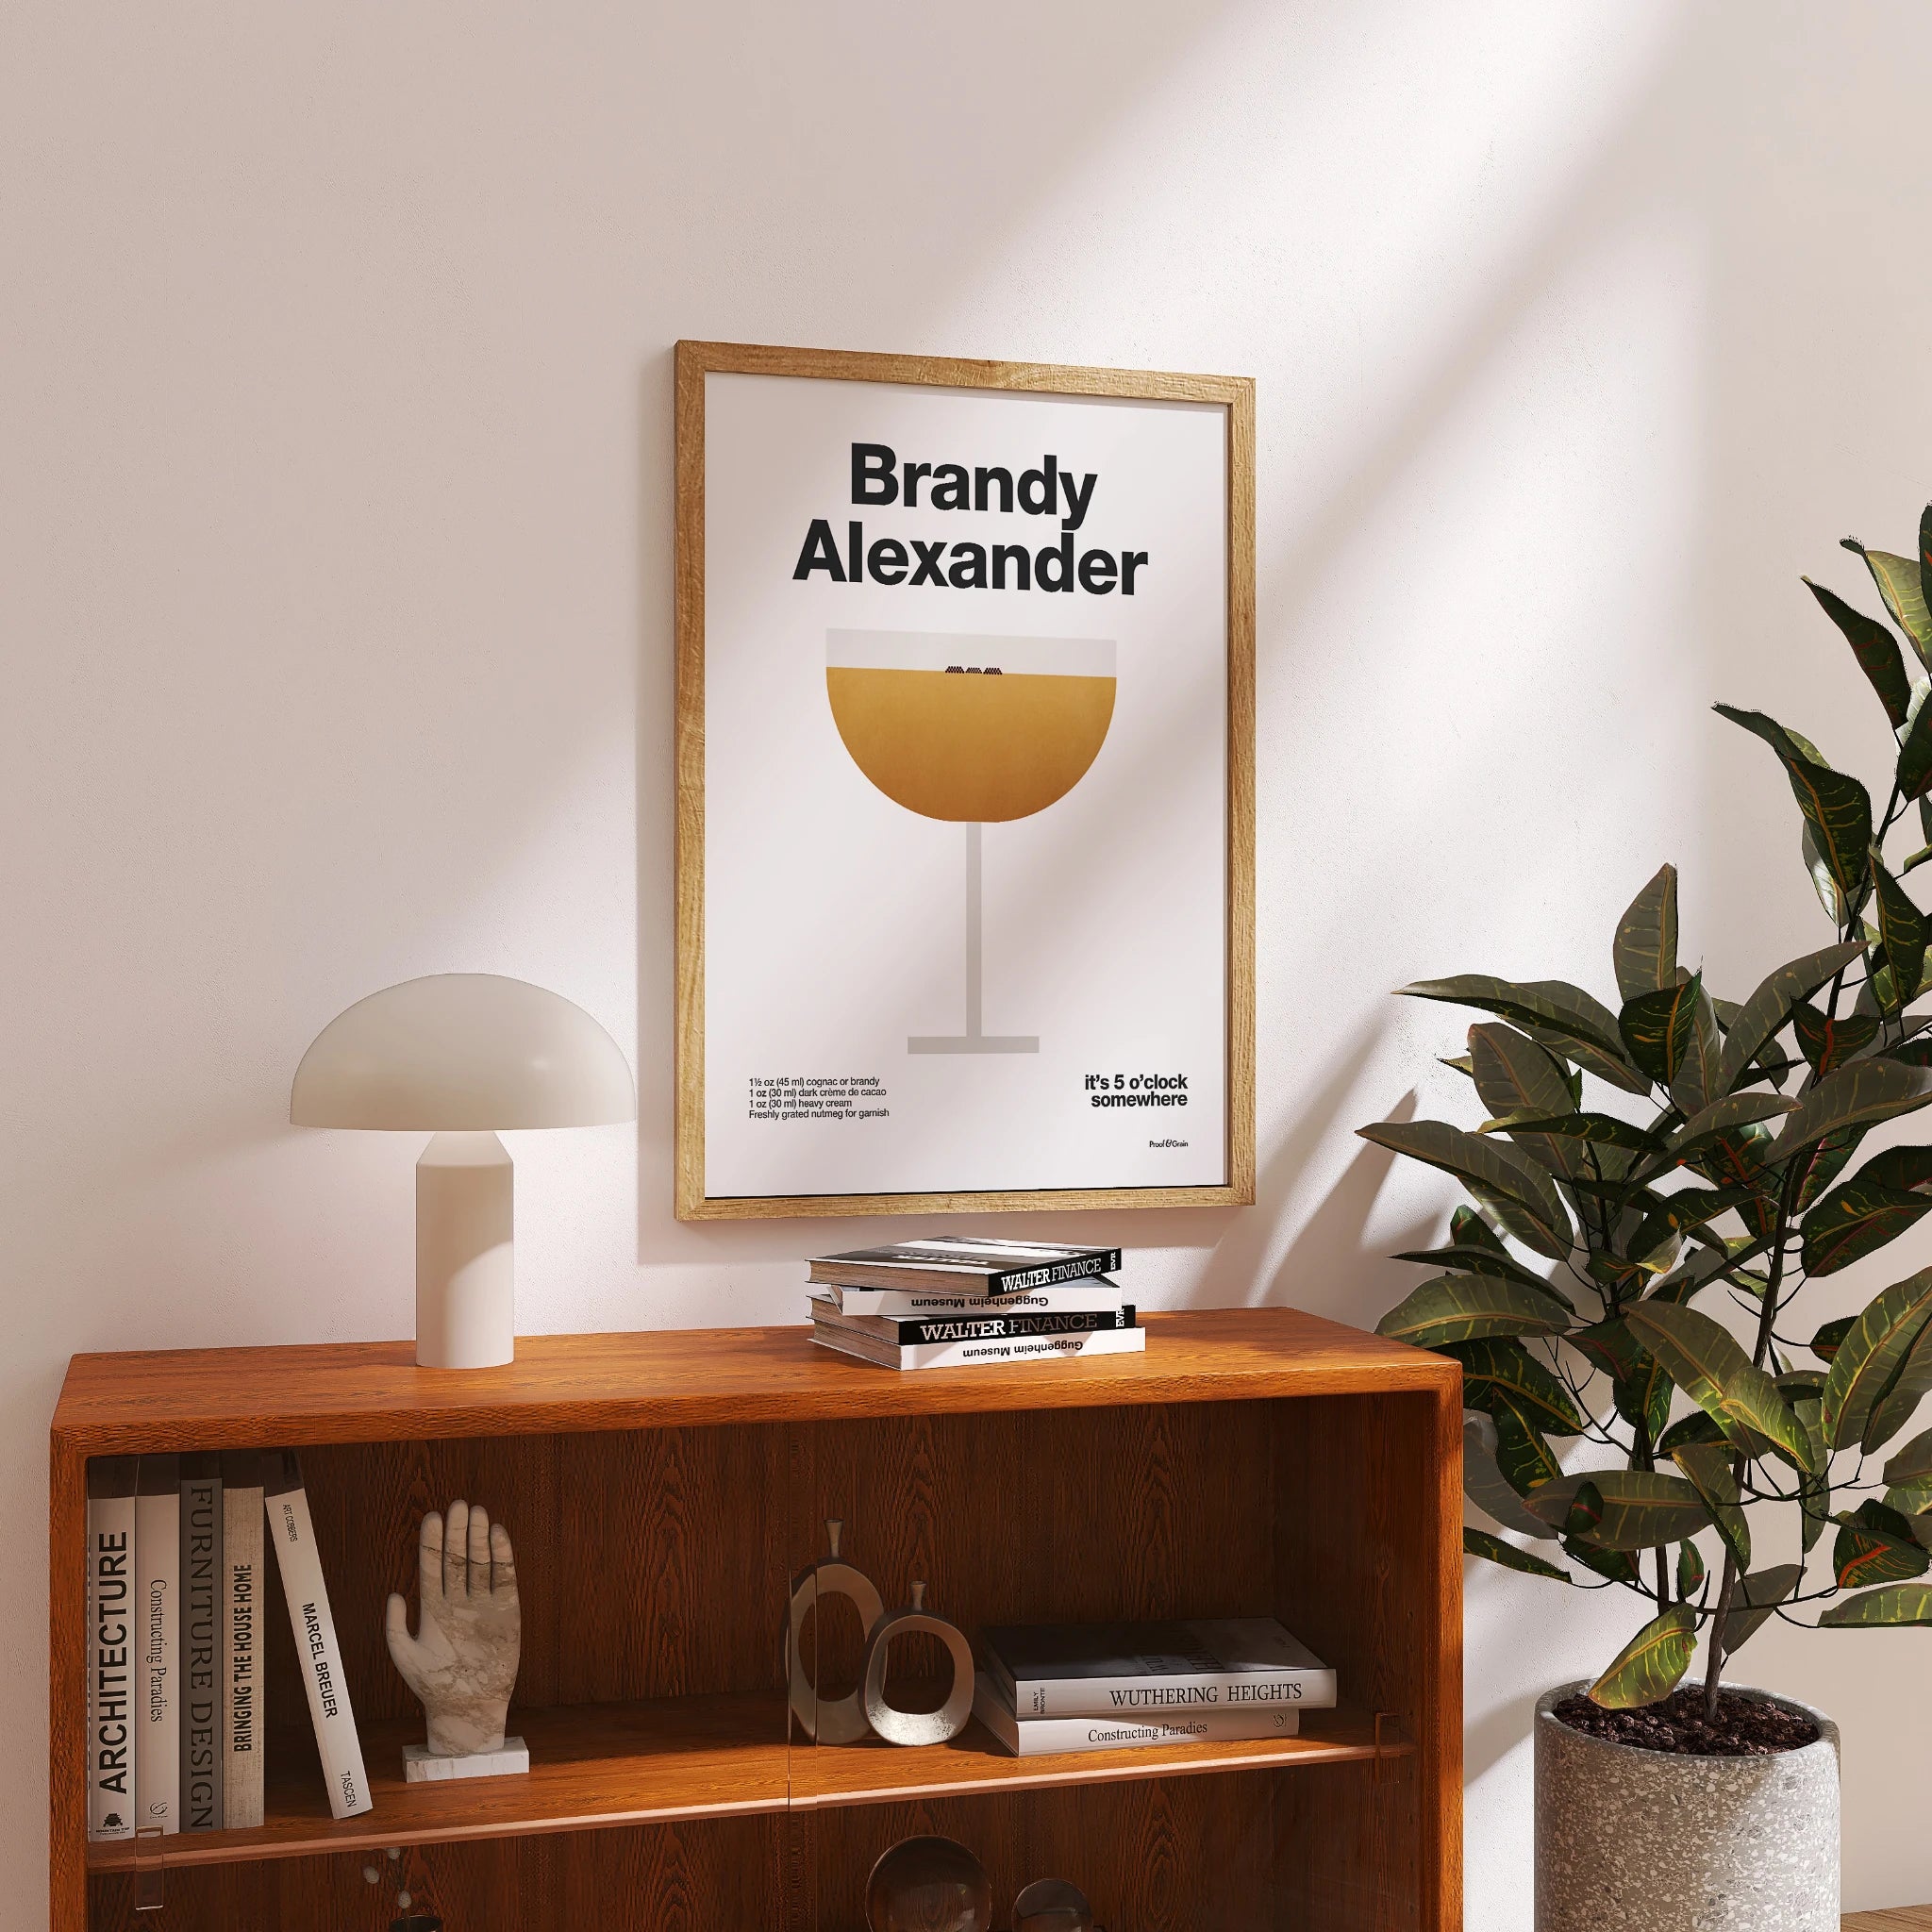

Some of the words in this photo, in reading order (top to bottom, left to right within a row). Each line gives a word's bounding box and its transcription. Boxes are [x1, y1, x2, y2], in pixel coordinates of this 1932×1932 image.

[851, 442, 1098, 530] Brandy
[792, 519, 1148, 595] Alexander
[749, 1089, 754, 1097] 1
[769, 1089, 782, 1098] (30
[784, 1088, 796, 1098] ml)
[798, 1088, 818, 1097] dark
[820, 1088, 846, 1096] crème
[848, 1088, 859, 1096] de
[776, 1077, 790, 1088] (45
[791, 1077, 804, 1088] ml)
[806, 1078, 838, 1088] cognac
[840, 1077, 849, 1086] or
[851, 1076, 880, 1088] brandy
[1113, 1074, 1125, 1090] 5
[769, 1099, 782, 1109] (30
[784, 1099, 796, 1109] ml)
[798, 1099, 824, 1109] heavy
[1091, 1091, 1189, 1108] somewhere
[749, 1109, 779, 1121] Freshly
[781, 1109, 809, 1120] grated
[811, 1109, 843, 1120] nutmeg
[845, 1108, 857, 1118] for
[858, 1108, 890, 1119] garnish
[1001, 1268, 1050, 1292] WALTER
[1051, 1257, 1102, 1281] FINANCE
[911, 1297, 964, 1307] Museum
[969, 1296, 1049, 1307] Guggenheim
[921, 1320, 1006, 1341] WALTER
[1008, 1314, 1098, 1335] FINANCE
[963, 1347, 1010, 1357] Museum
[1014, 1341, 1083, 1355] Guggenheim
[283, 1504, 292, 1516] ART
[191, 1487, 213, 1690] FURNITURE
[234, 1564, 252, 1603] HOME
[146, 1579, 167, 1663] Constructing
[234, 1606, 252, 1651] HOUSE
[98, 1532, 127, 1794] ARCHITECTURE
[234, 1655, 252, 1682] THE
[303, 1603, 325, 1660] MARCEL
[315, 1661, 338, 1719] BREUER
[150, 1667, 167, 1723] Paradies
[1109, 1687, 1218, 1706] WUTHERING
[1227, 1683, 1303, 1702] HEIGHTS
[234, 1687, 252, 1752] BRINGING
[1089, 1725, 1159, 1742] Constructing
[1162, 1722, 1208, 1737] Paradies
[191, 1700, 213, 1828] DESIGN
[341, 1771, 358, 1807] TASCEN
